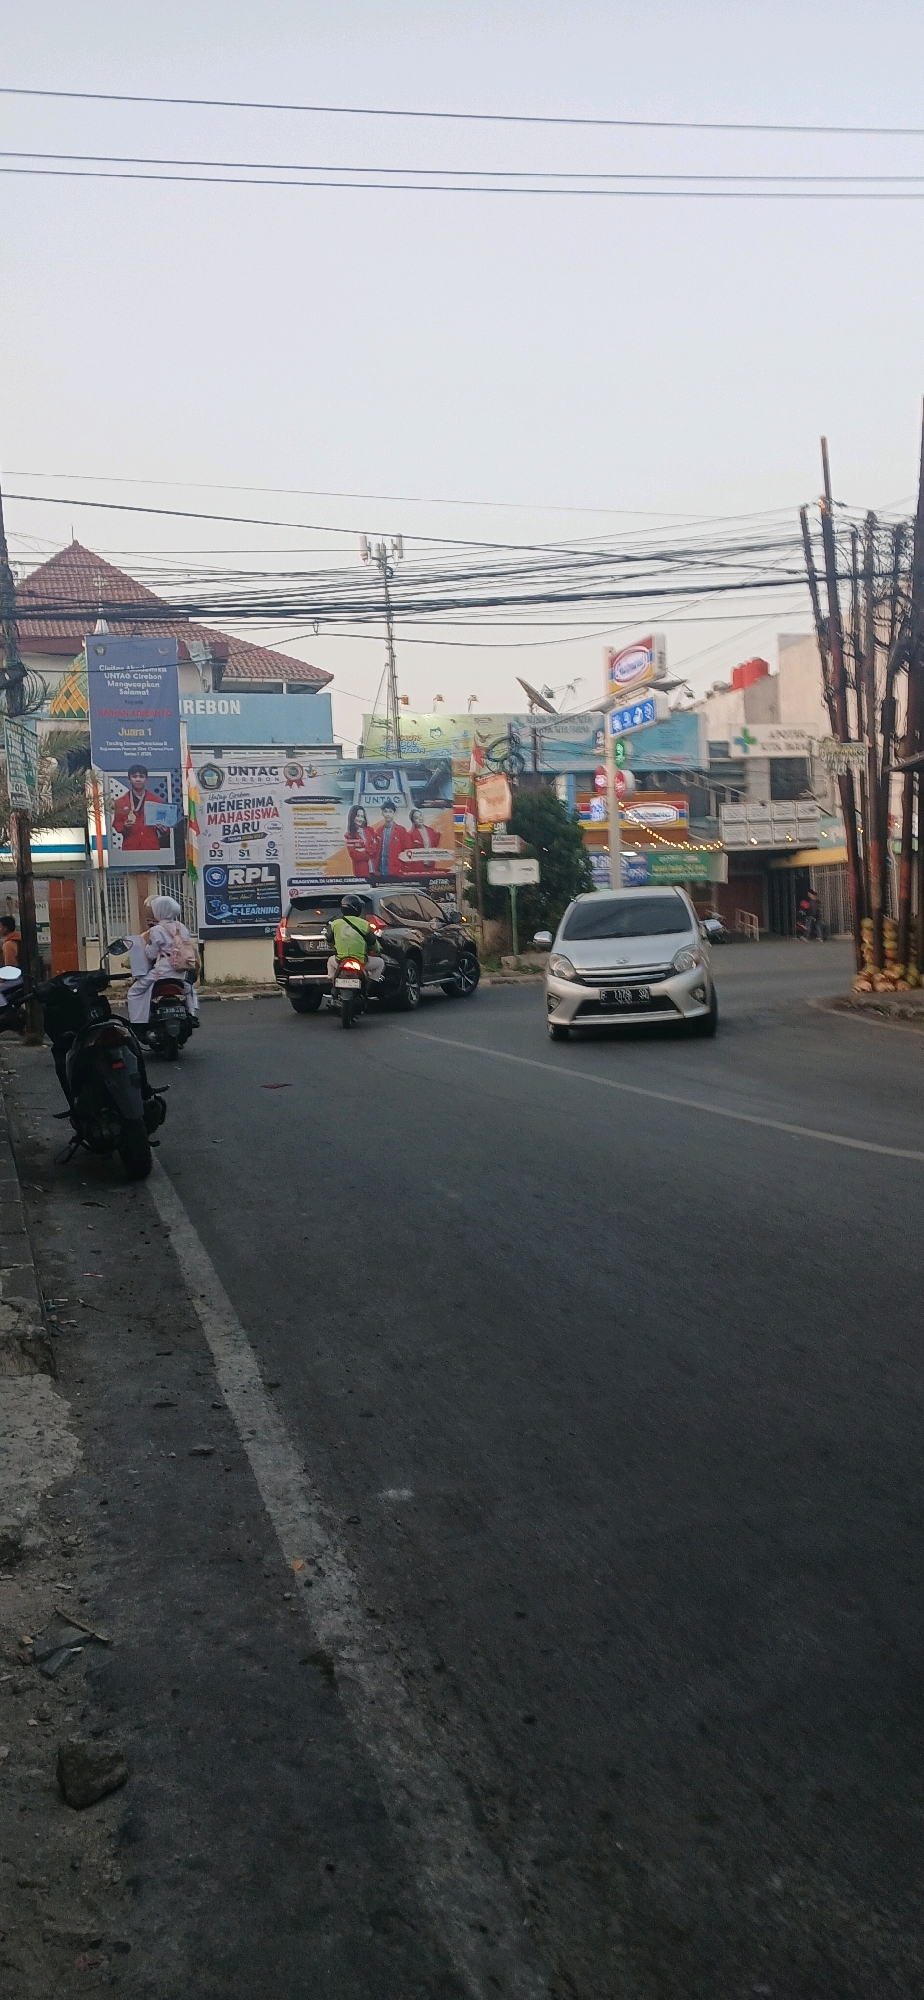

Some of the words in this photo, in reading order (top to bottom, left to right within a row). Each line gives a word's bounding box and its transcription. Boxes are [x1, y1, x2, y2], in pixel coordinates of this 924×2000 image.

[107, 680, 160, 689] Mengucapkan
[119, 688, 150, 696] Selamat
[179, 700, 241, 715] IREBON
[118, 727, 145, 737] Juara
[147, 727, 153, 736] 1
[227, 766, 278, 776] UNTAG
[207, 796, 274, 813] MENERIMA
[364, 796, 401, 804] UNTAG
[207, 807, 280, 825] MAHASISWA
[222, 821, 260, 836] BARU
[209, 849, 224, 857] D3
[238, 849, 250, 857] S1
[265, 849, 278, 857] S2
[228, 867, 276, 885] RPL
[232, 906, 280, 916] E-LEARNING
